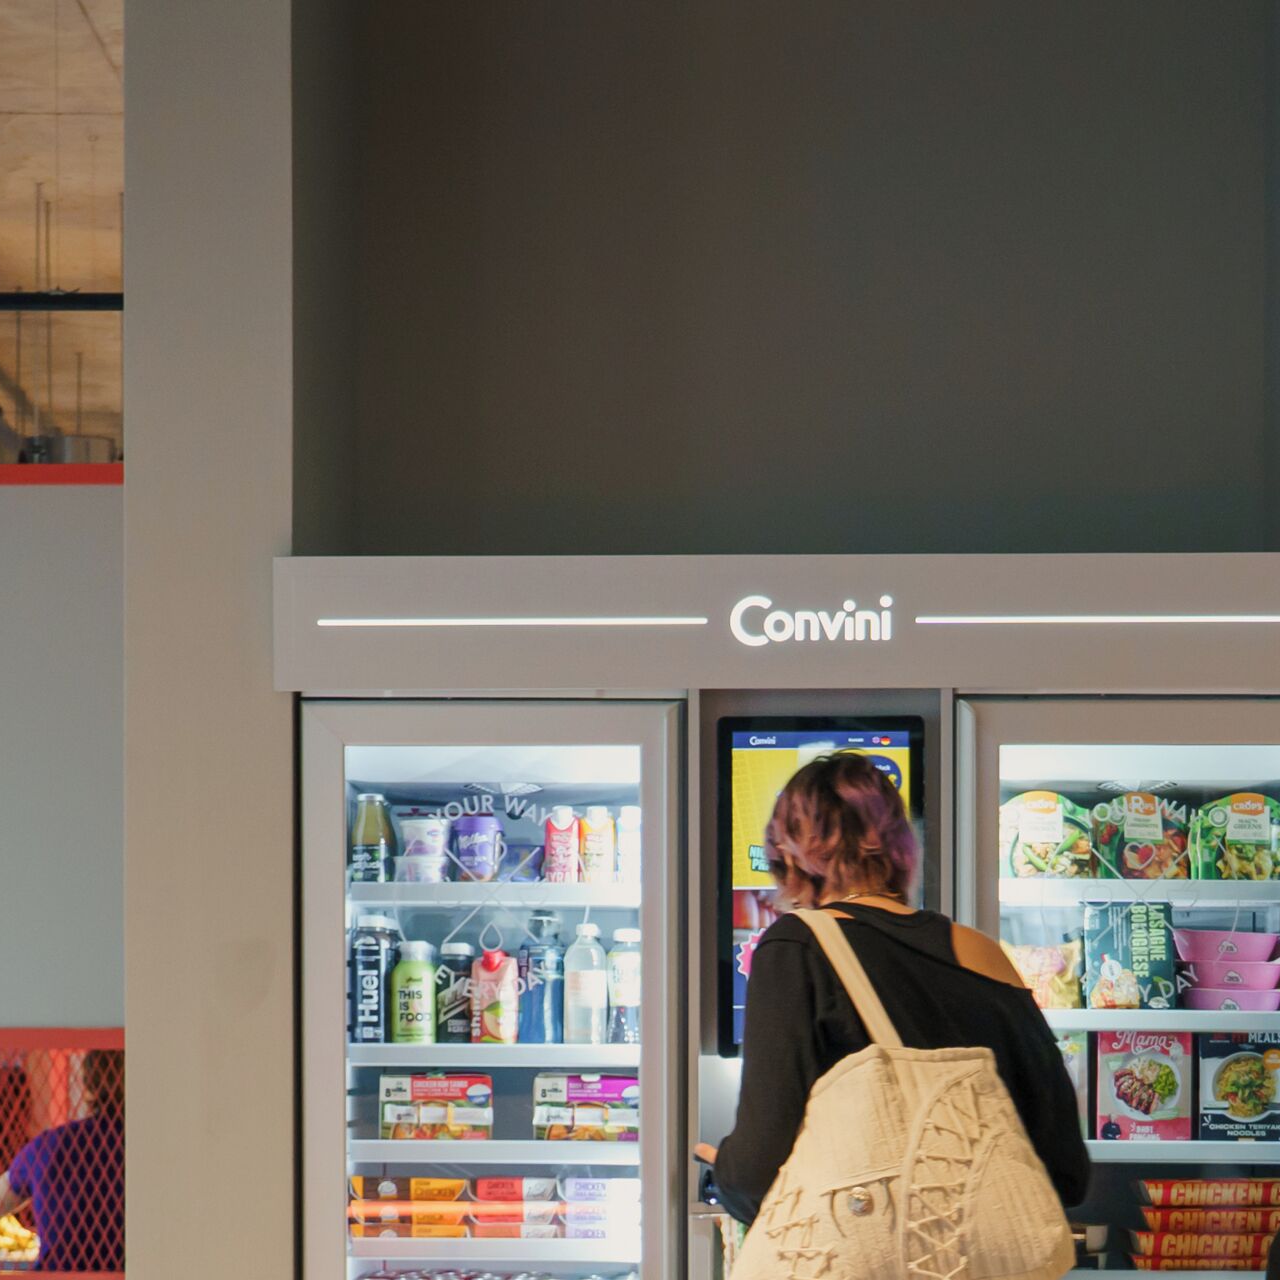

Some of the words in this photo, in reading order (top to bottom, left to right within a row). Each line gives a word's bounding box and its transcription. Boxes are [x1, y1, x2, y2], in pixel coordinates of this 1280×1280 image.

[729, 595, 893, 647] Convini
[428, 794, 495, 826] YOUR
[504, 794, 552, 828] WAY
[1130, 905, 1150, 978] BOLOGNESE
[1148, 904, 1167, 961] LASAGNE
[1158, 964, 1200, 1001] DAY
[357, 969, 379, 1023] Huel
[398, 990, 423, 1000] THIS
[400, 1002, 410, 1012] IS
[400, 1012, 433, 1023] FOOD
[1111, 1031, 1173, 1055] Mama
[1209, 1123, 1246, 1131] CHICKEN
[1170, 1182, 1263, 1207] CHICKEN
[1169, 1211, 1262, 1234] CHICKEN
[1160, 1233, 1255, 1257] CHICKEN
